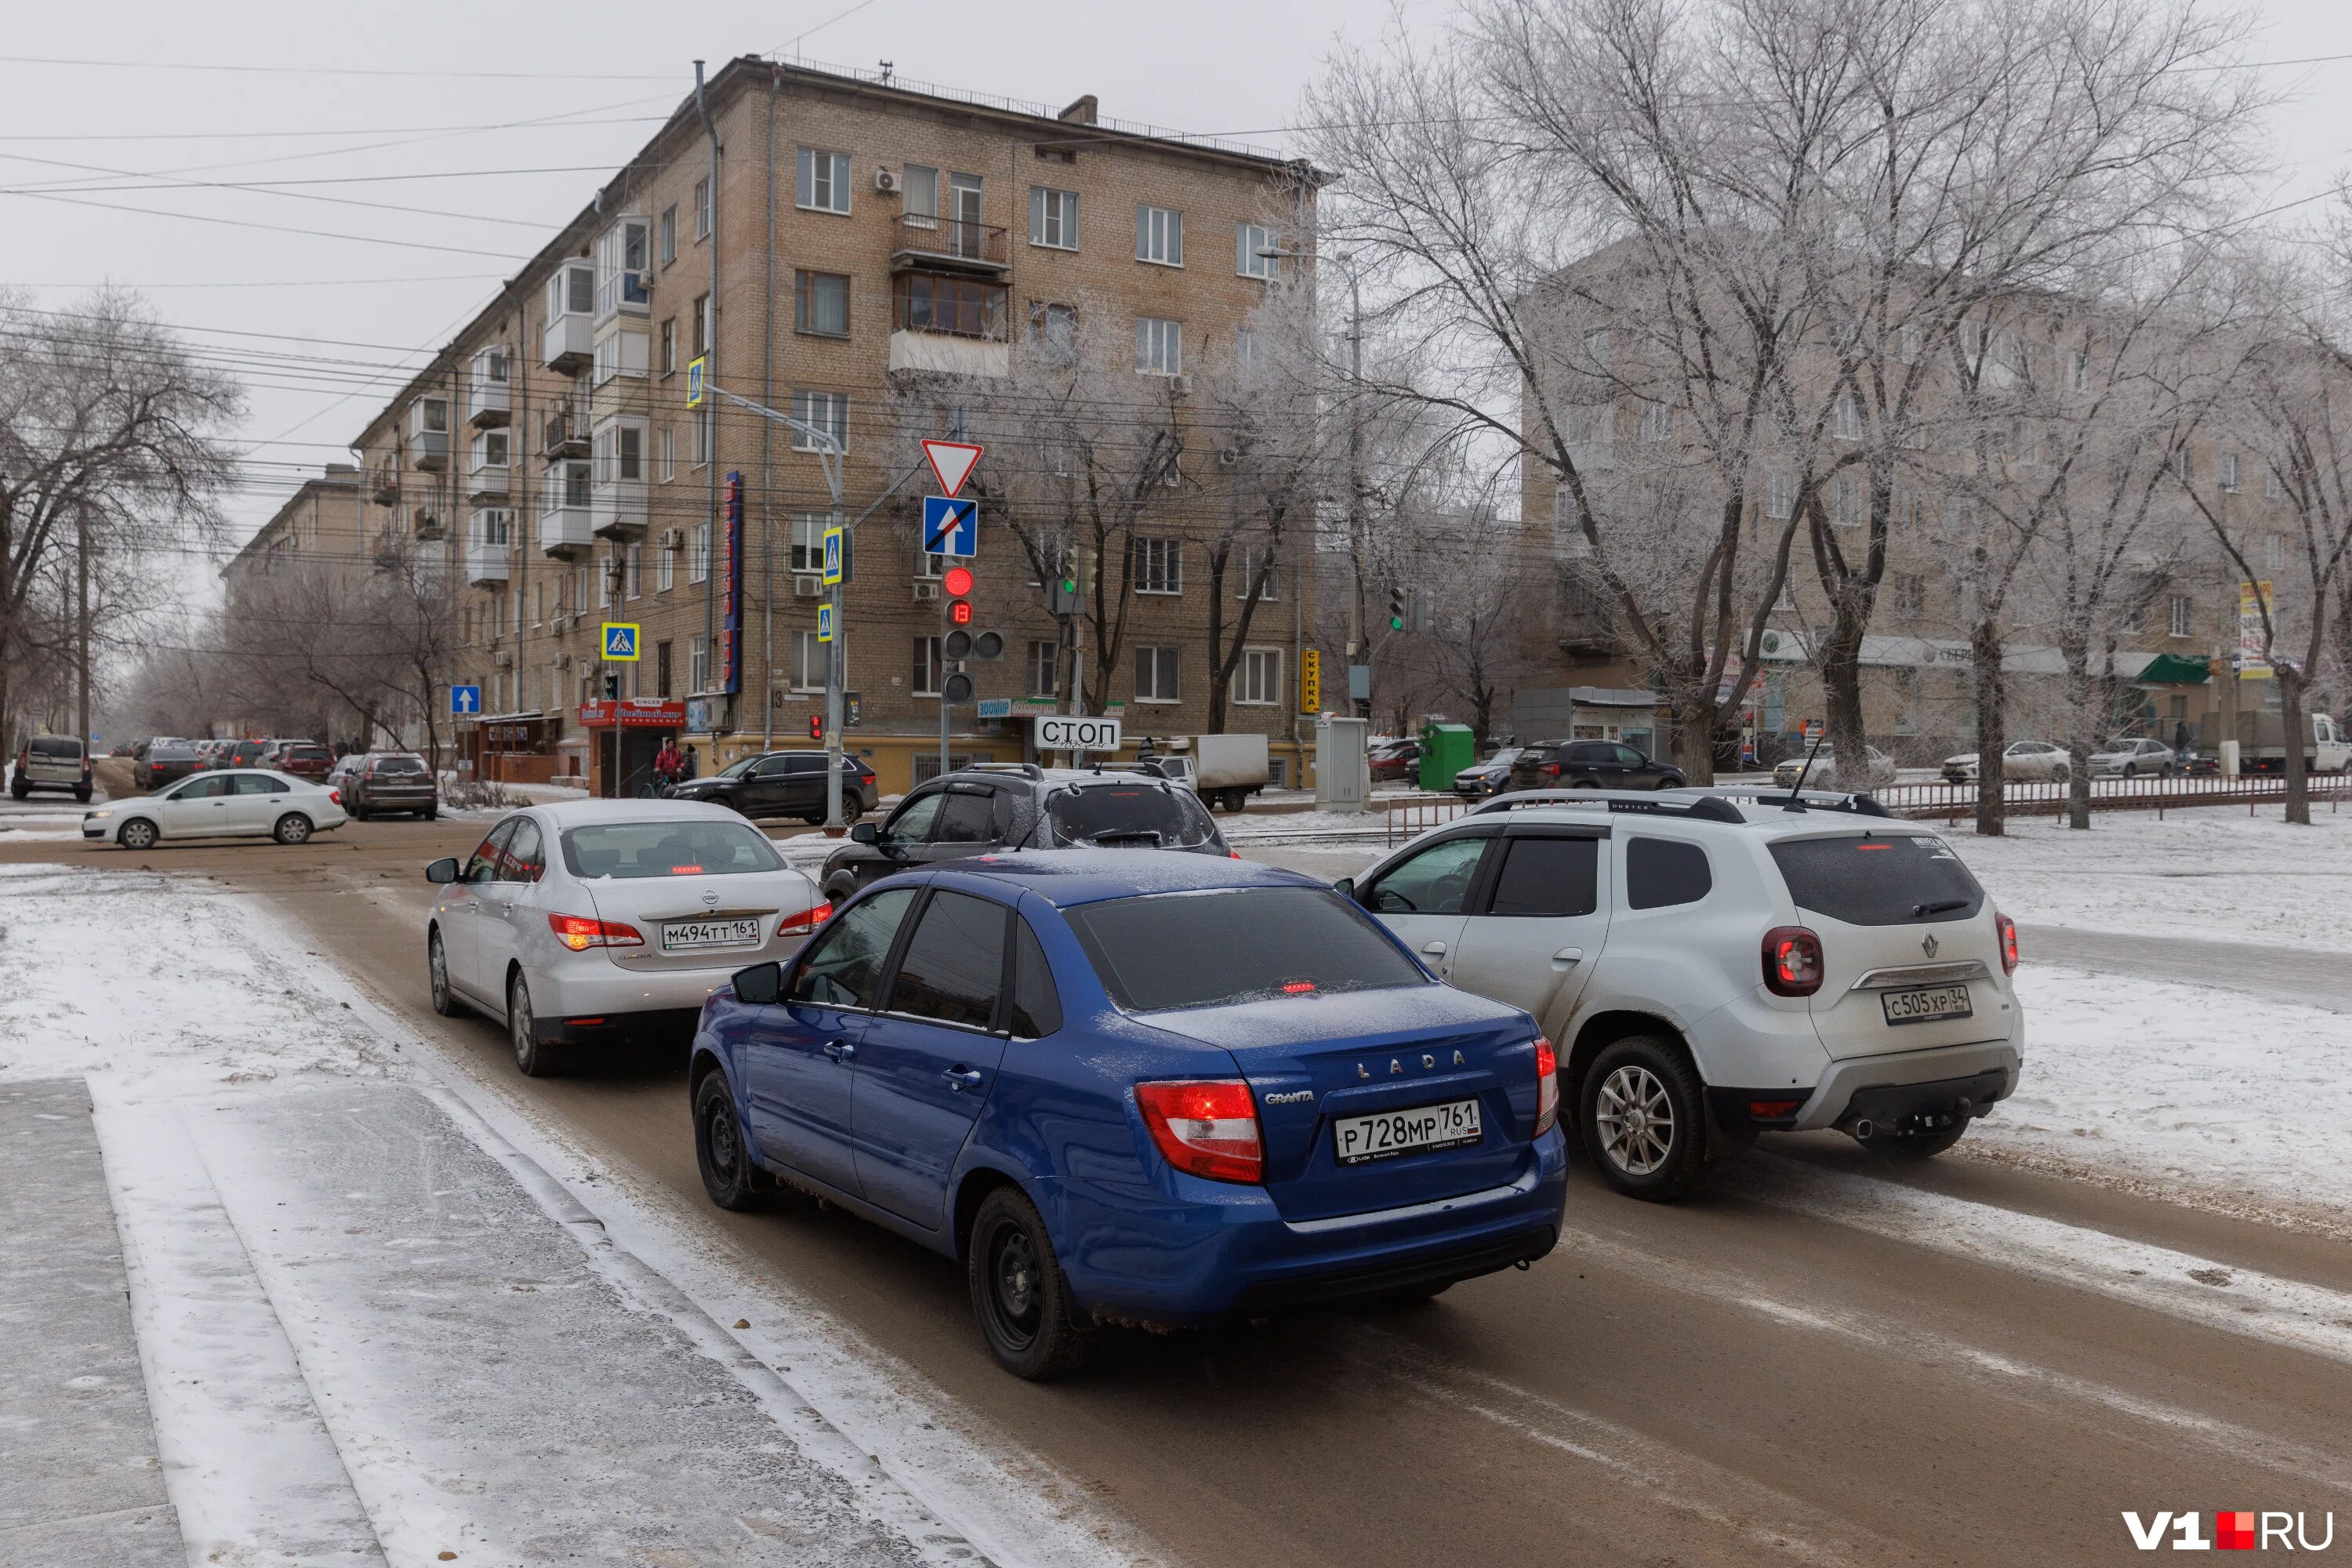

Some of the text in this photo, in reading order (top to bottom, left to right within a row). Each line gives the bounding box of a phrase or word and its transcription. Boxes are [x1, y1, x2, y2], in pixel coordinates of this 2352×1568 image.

[955, 604, 968, 622] 13
[1307, 652, 1316, 706] СКУПКА
[980, 702, 1009, 715] ЗООМИР
[1043, 721, 1115, 744] СТОП
[668, 921, 755, 942] М494ТТ 161
[1891, 989, 1965, 1016] С505ХР 34
[1357, 1050, 1465, 1079] LADA
[1265, 1090, 1315, 1105] GRANTA
[1345, 1103, 1475, 1152] Р728МР 761
[1450, 1127, 1467, 1137] RUS
